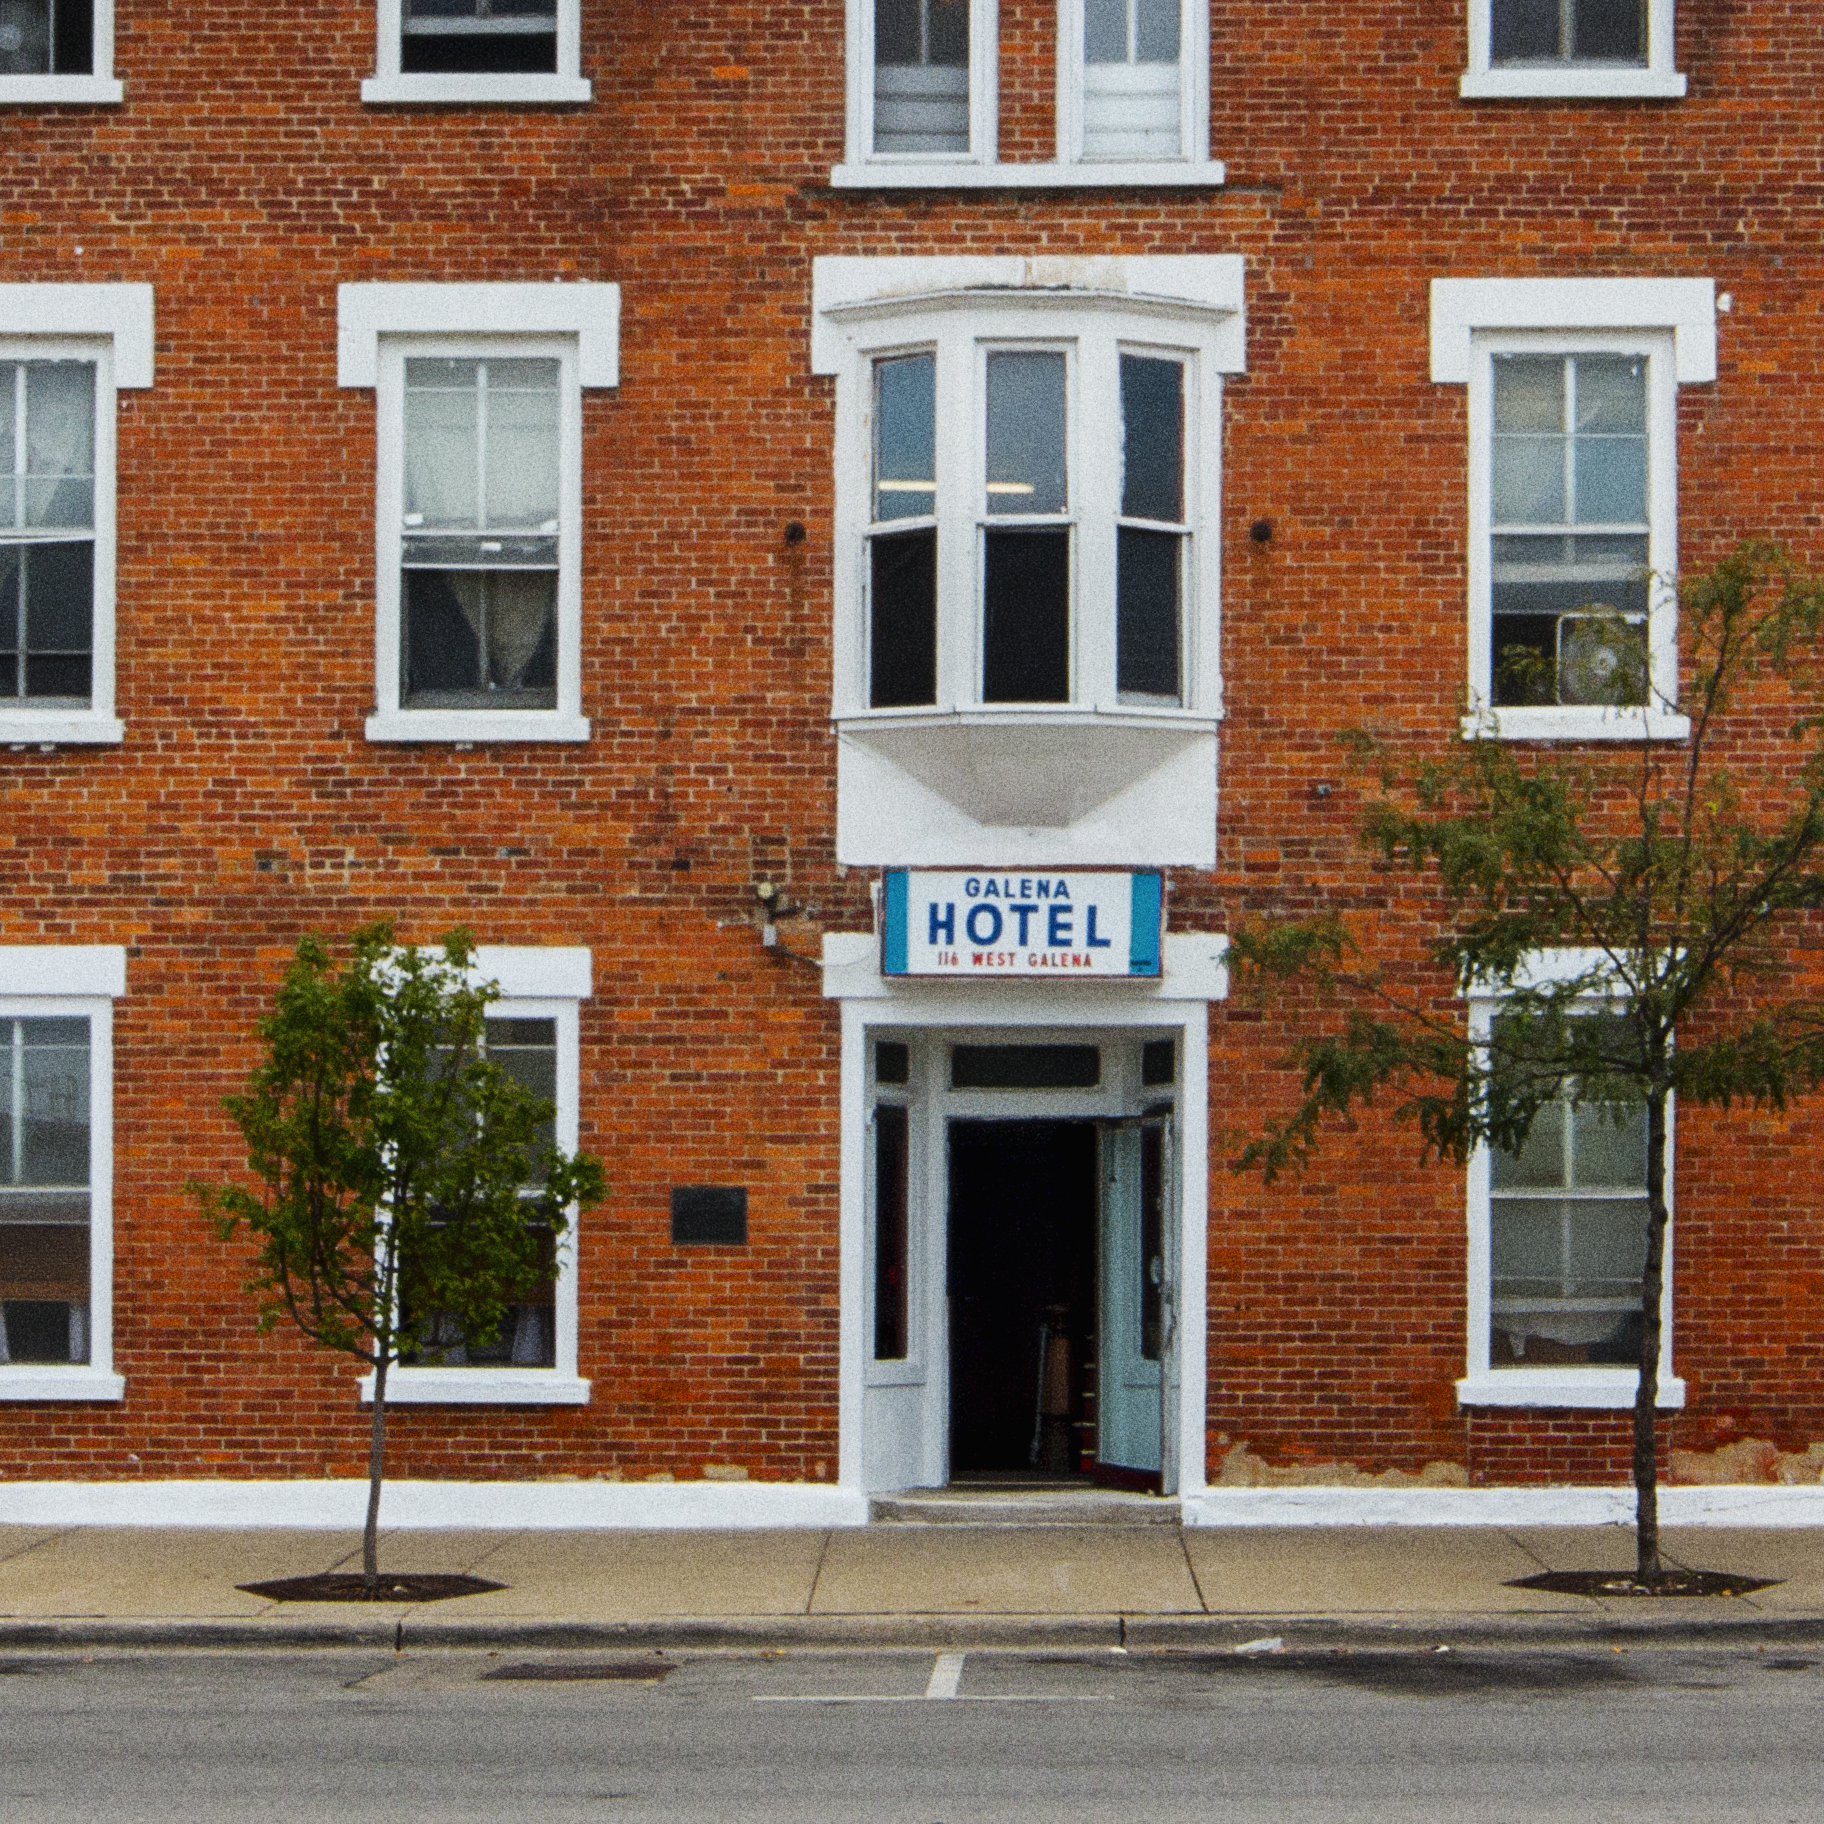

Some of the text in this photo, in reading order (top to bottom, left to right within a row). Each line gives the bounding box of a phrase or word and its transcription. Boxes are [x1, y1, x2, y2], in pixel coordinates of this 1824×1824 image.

[964, 877, 1071, 900] GALENA
[927, 902, 1112, 948] HOTEL
[937, 951, 1093, 968] 116 WEST GALENA
